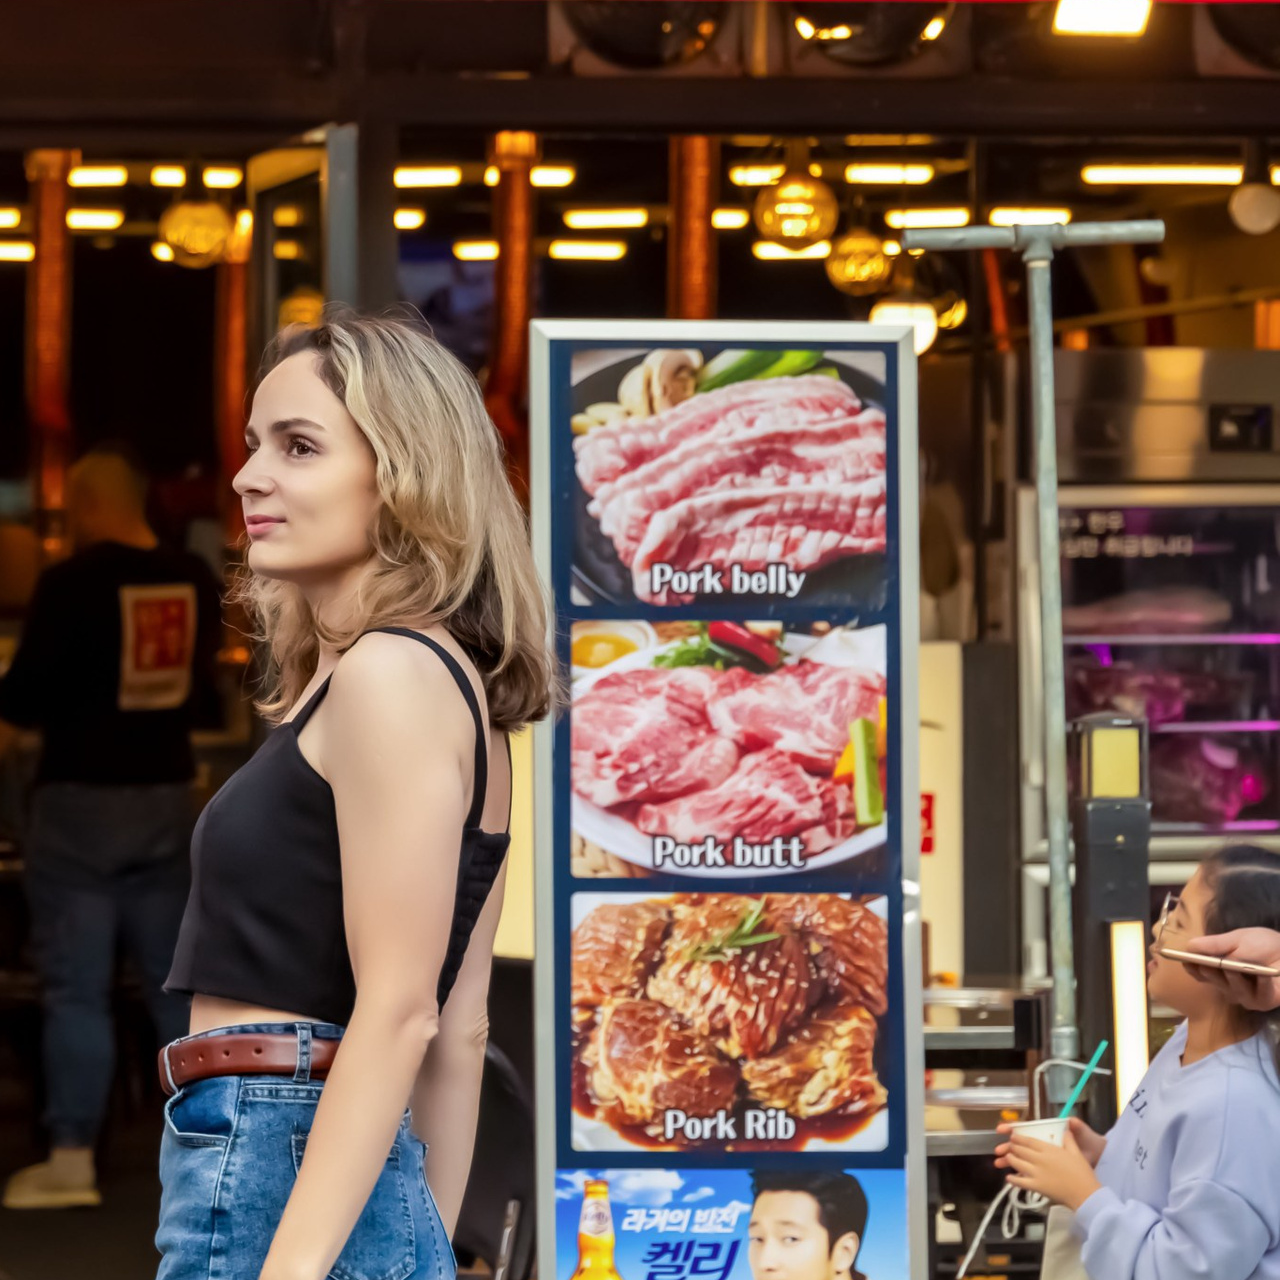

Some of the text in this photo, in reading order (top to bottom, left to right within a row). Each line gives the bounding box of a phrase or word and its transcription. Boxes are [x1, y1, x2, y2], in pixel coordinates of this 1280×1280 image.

[652, 562, 806, 598] Pork belly
[653, 835, 805, 867] Pork butt
[664, 1107, 796, 1142] Pork Rib
[621, 1208, 692, 1233] 라거의
